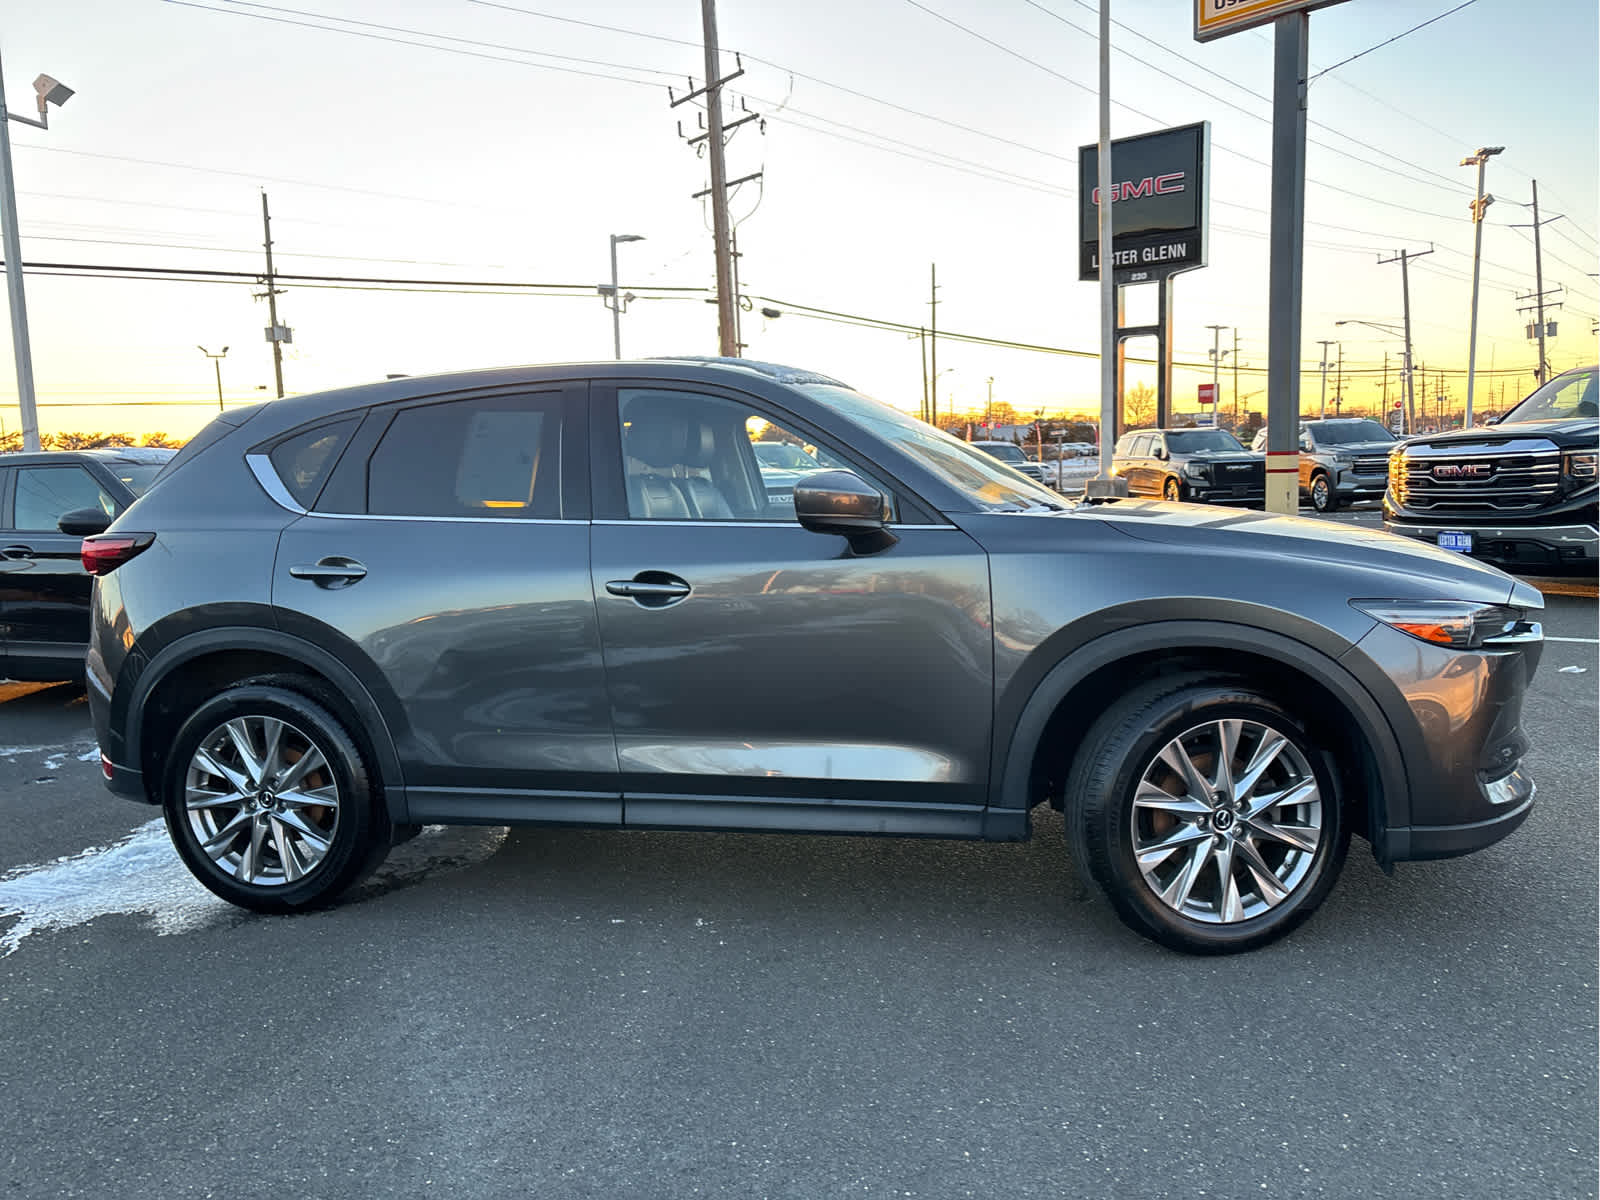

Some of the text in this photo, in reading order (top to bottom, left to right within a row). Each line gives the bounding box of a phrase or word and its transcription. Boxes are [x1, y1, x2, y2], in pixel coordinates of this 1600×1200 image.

[1092, 172, 1185, 205] GMC
[1142, 243, 1186, 262] GLENN
[1433, 464, 1491, 477] GMC
